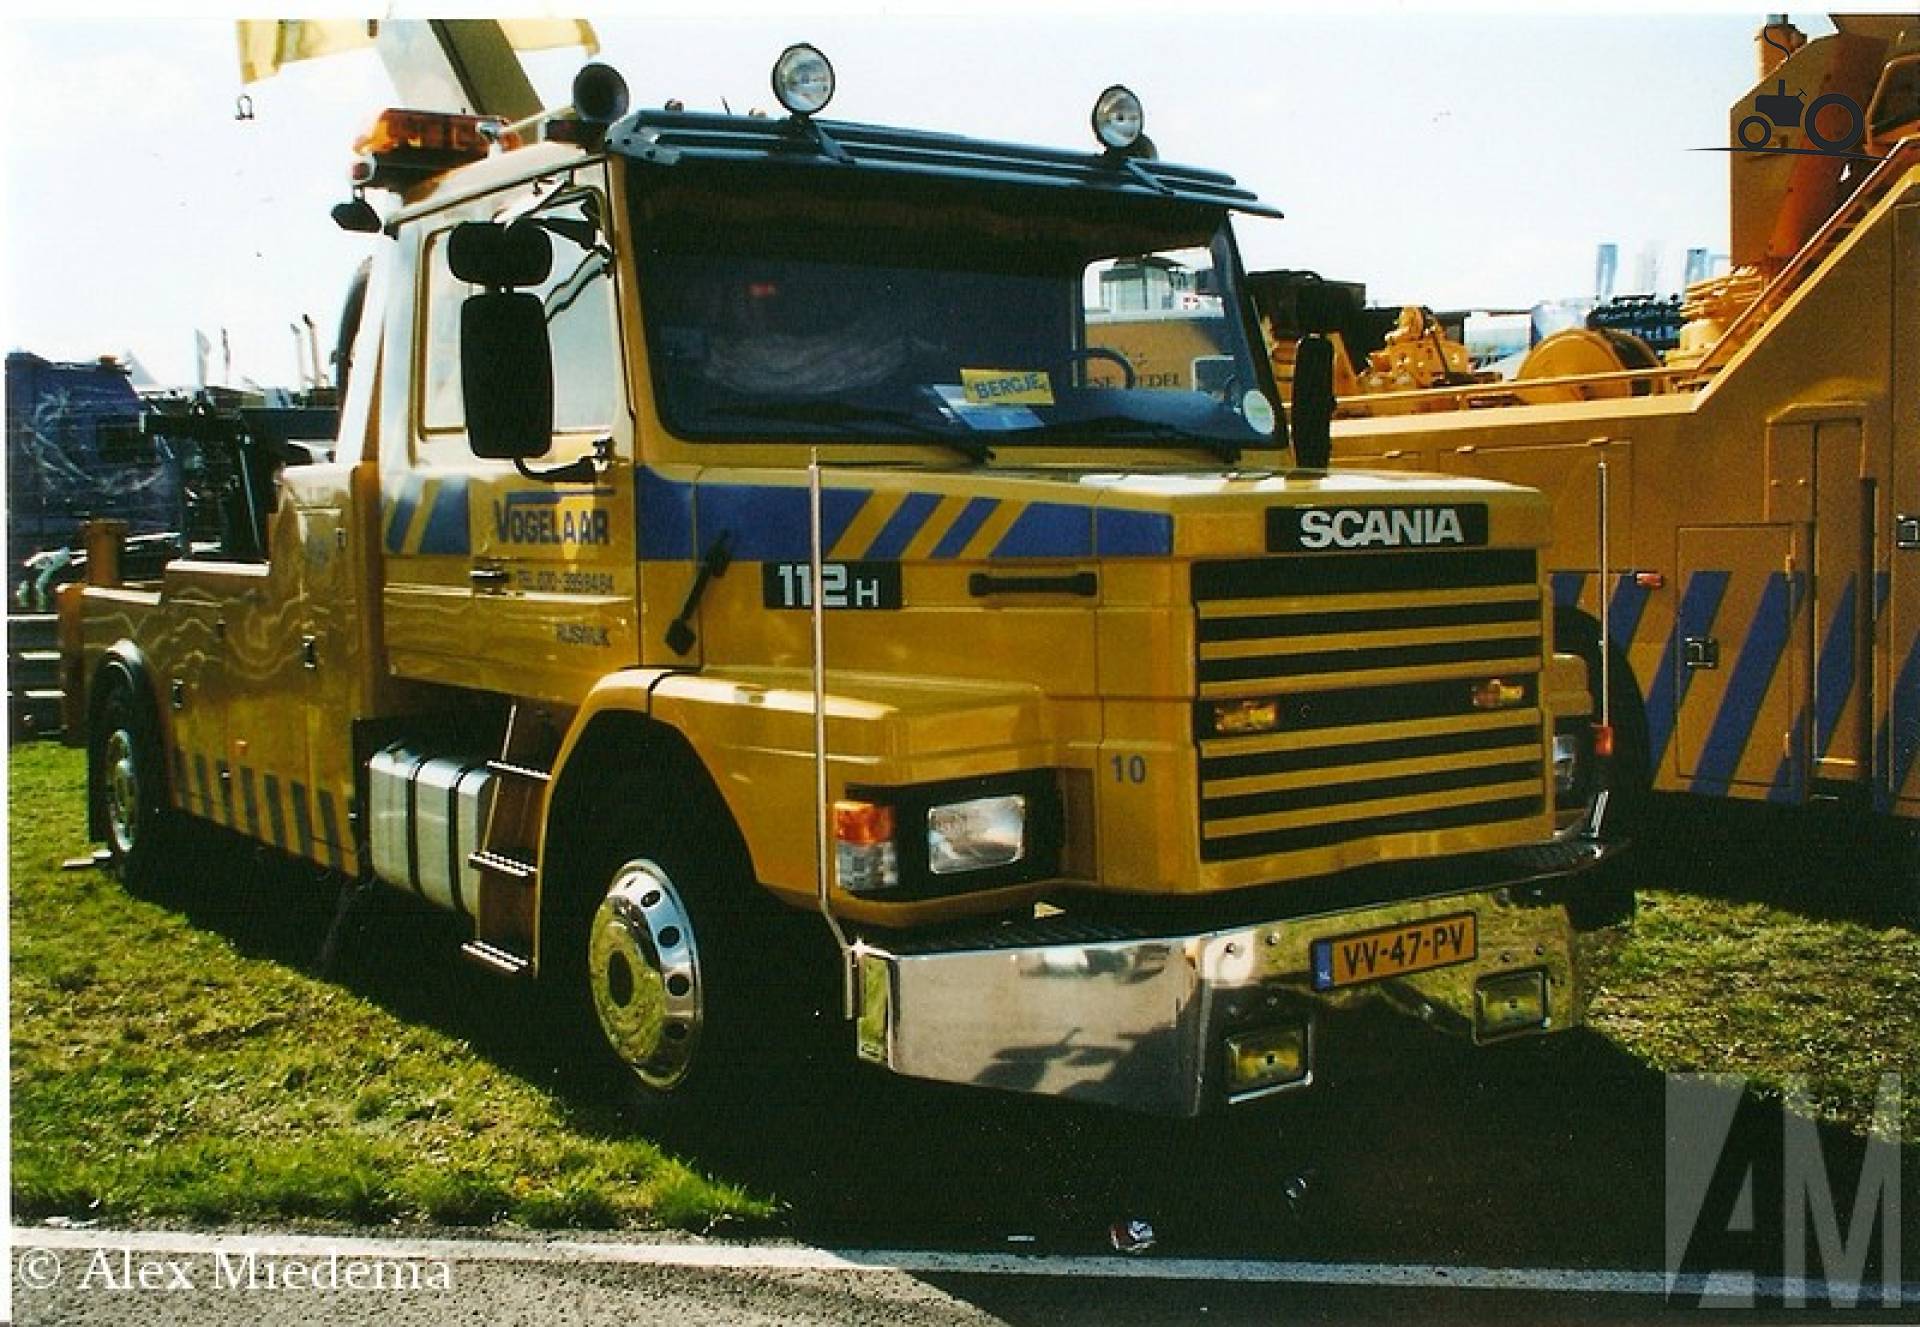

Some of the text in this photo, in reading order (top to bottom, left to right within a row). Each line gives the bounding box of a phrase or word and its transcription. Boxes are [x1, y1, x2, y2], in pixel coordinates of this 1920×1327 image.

[494, 498, 611, 543] VOGELAAR
[1300, 508, 1465, 547] SCANIA
[778, 564, 879, 606] 112 H
[1111, 755, 1146, 784] 10
[1343, 921, 1465, 977] VV-47-PV
